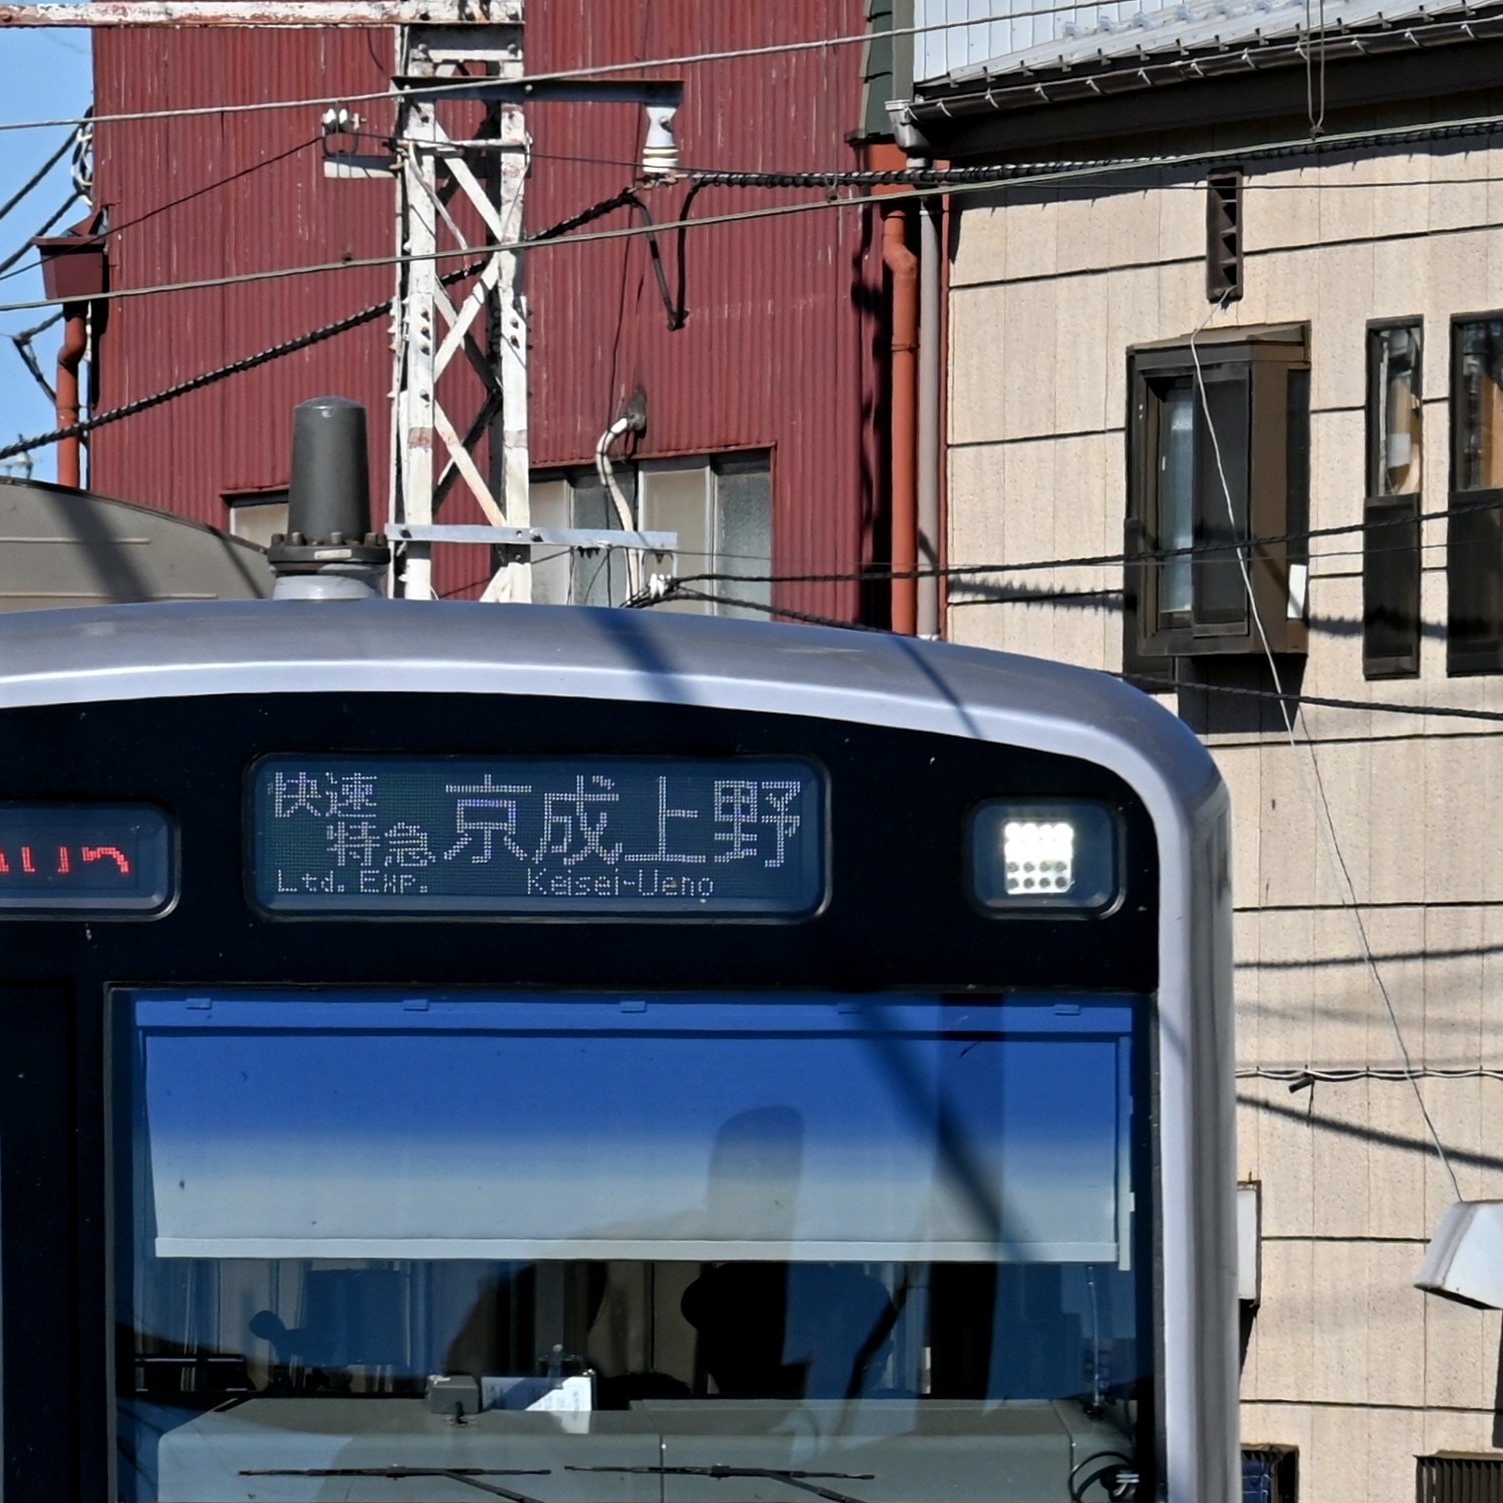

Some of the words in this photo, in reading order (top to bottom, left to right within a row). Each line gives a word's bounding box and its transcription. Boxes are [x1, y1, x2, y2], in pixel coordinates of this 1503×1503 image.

[267, 772, 378, 818] 快速
[325, 821, 437, 867] 特急
[443, 774, 801, 868] 京成上野
[277, 869, 345, 893] Ltd.
